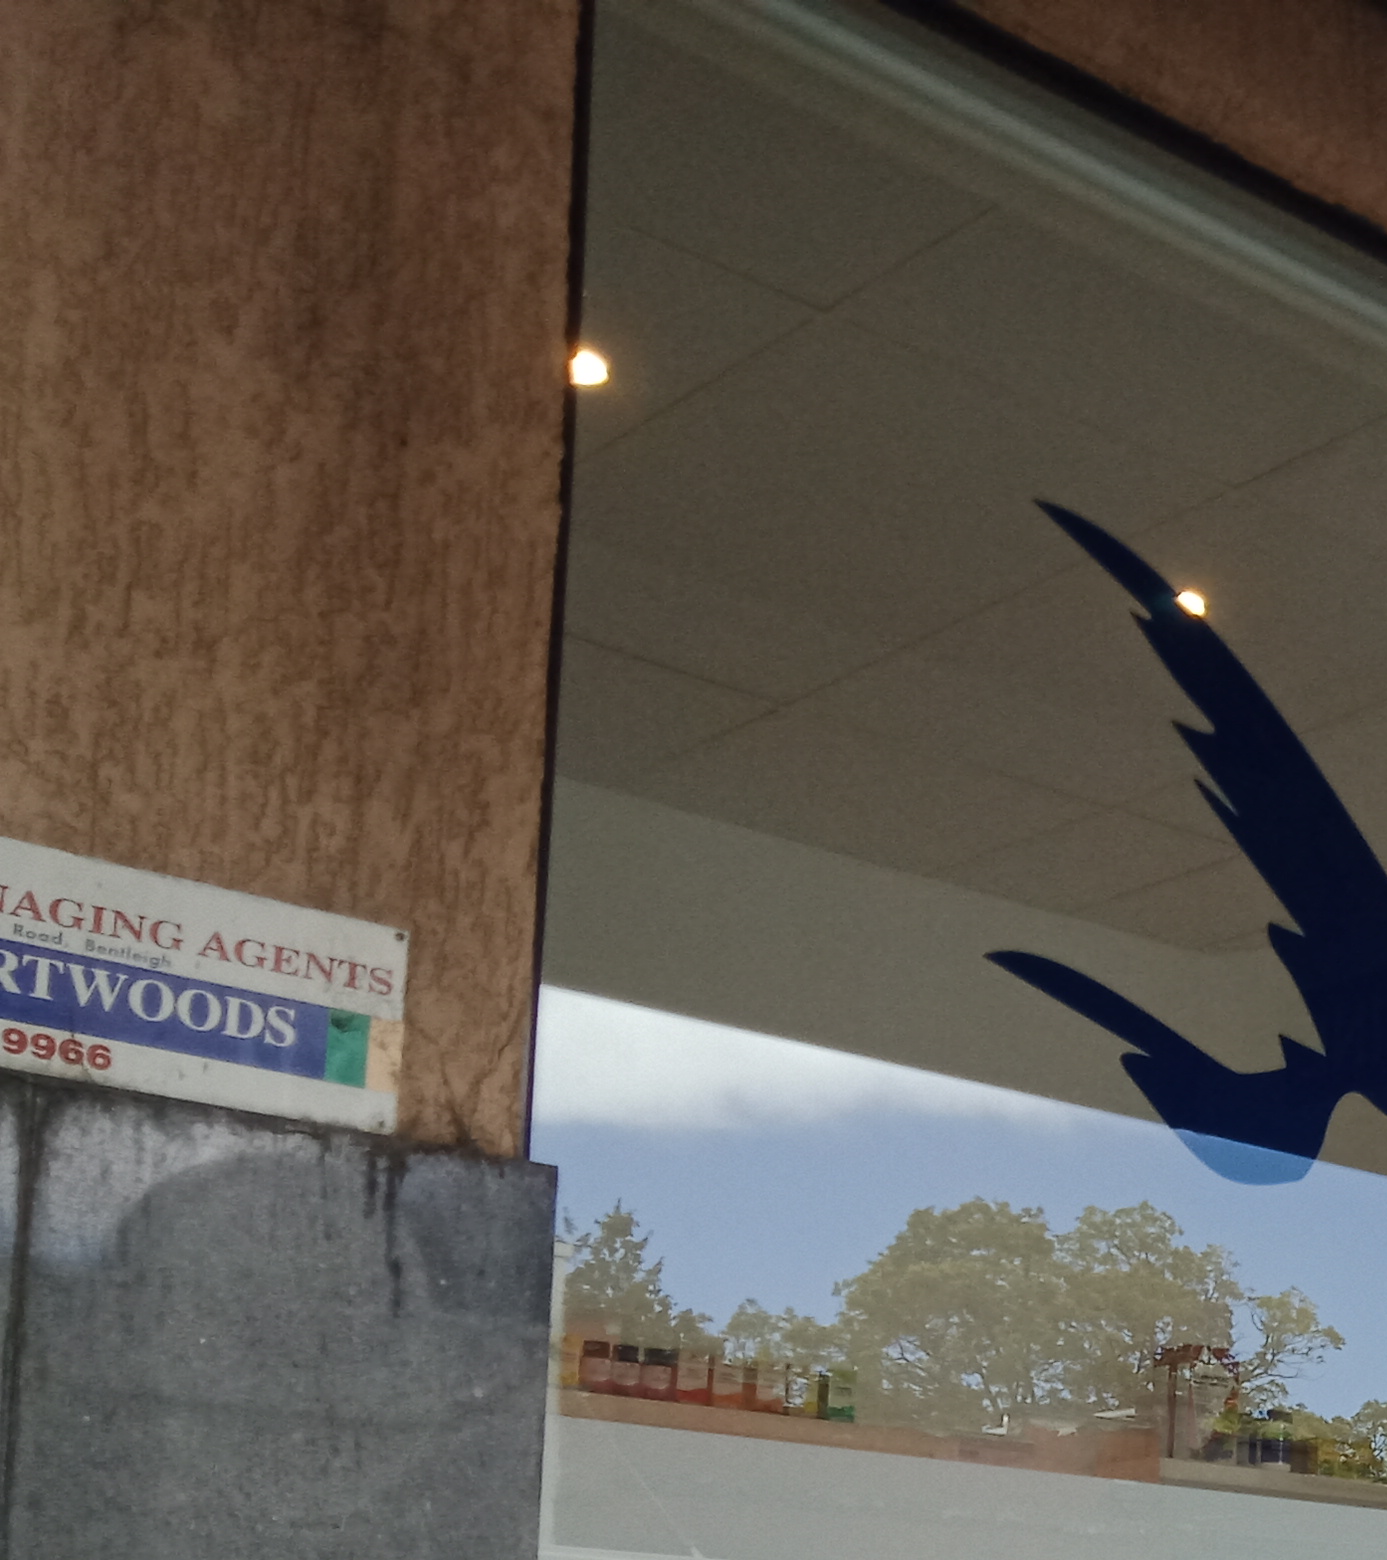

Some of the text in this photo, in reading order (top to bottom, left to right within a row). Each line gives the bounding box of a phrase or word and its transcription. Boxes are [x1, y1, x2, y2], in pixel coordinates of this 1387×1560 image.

[0, 884, 395, 996] AGING AGENTS
[84, 939, 172, 969] Bentleigh
[1, 1026, 112, 1072] 9966
